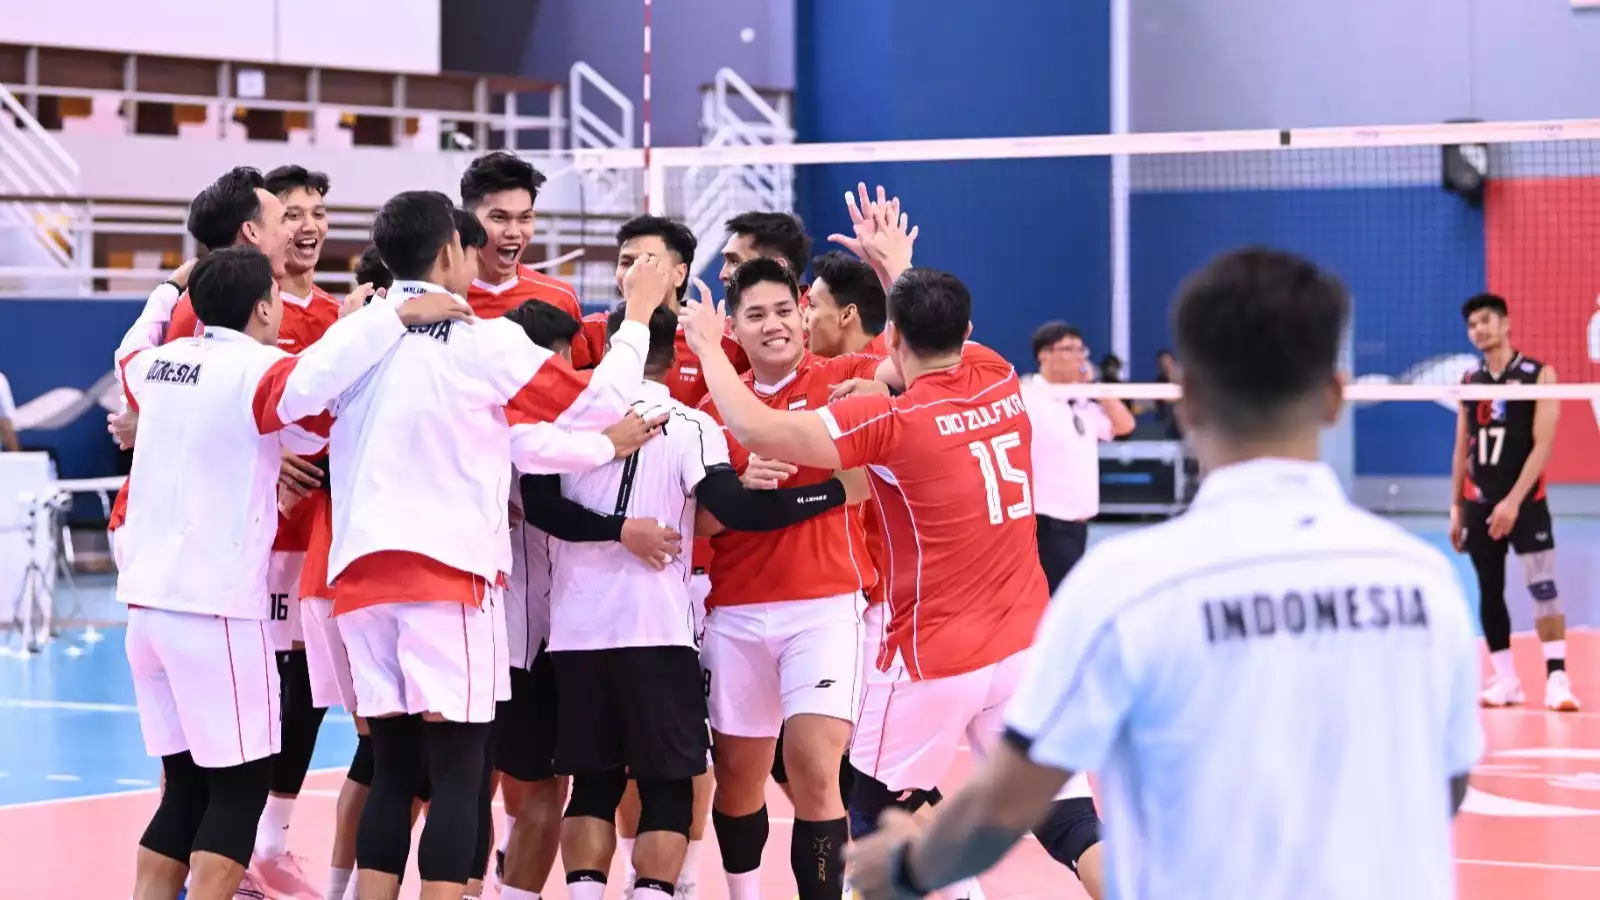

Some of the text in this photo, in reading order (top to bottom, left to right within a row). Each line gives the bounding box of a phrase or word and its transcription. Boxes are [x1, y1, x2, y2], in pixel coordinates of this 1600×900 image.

[934, 412, 966, 436] DIO
[1478, 427, 1506, 466] 17
[968, 431, 1033, 526] 15
[270, 592, 289, 621] 16
[1202, 585, 1430, 645] INDONESIA
